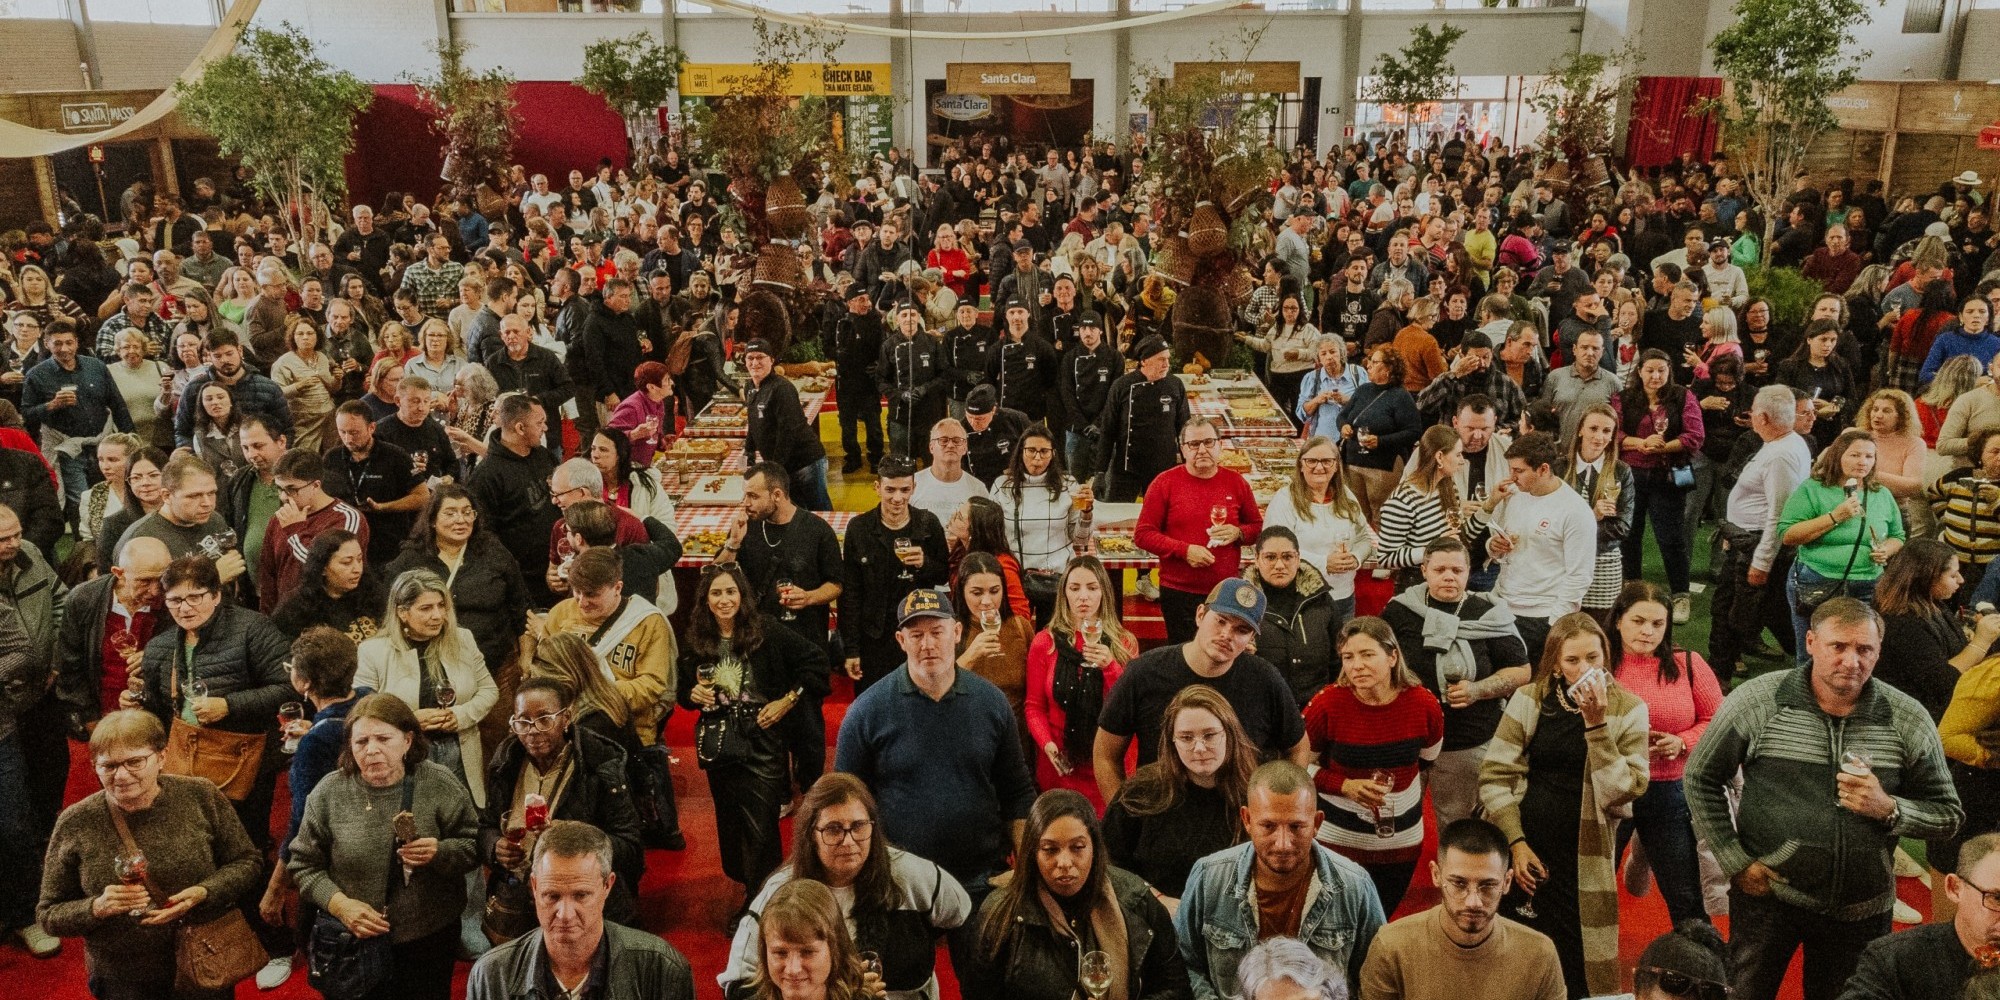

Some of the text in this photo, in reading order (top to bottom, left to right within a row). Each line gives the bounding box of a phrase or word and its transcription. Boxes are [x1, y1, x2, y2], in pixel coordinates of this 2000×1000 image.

[823, 70, 873, 82] CHECK BAR
[981, 73, 1036, 83] Santa Clara
[935, 99, 988, 110] Santa Clara
[80, 106, 107, 122] SANTA
